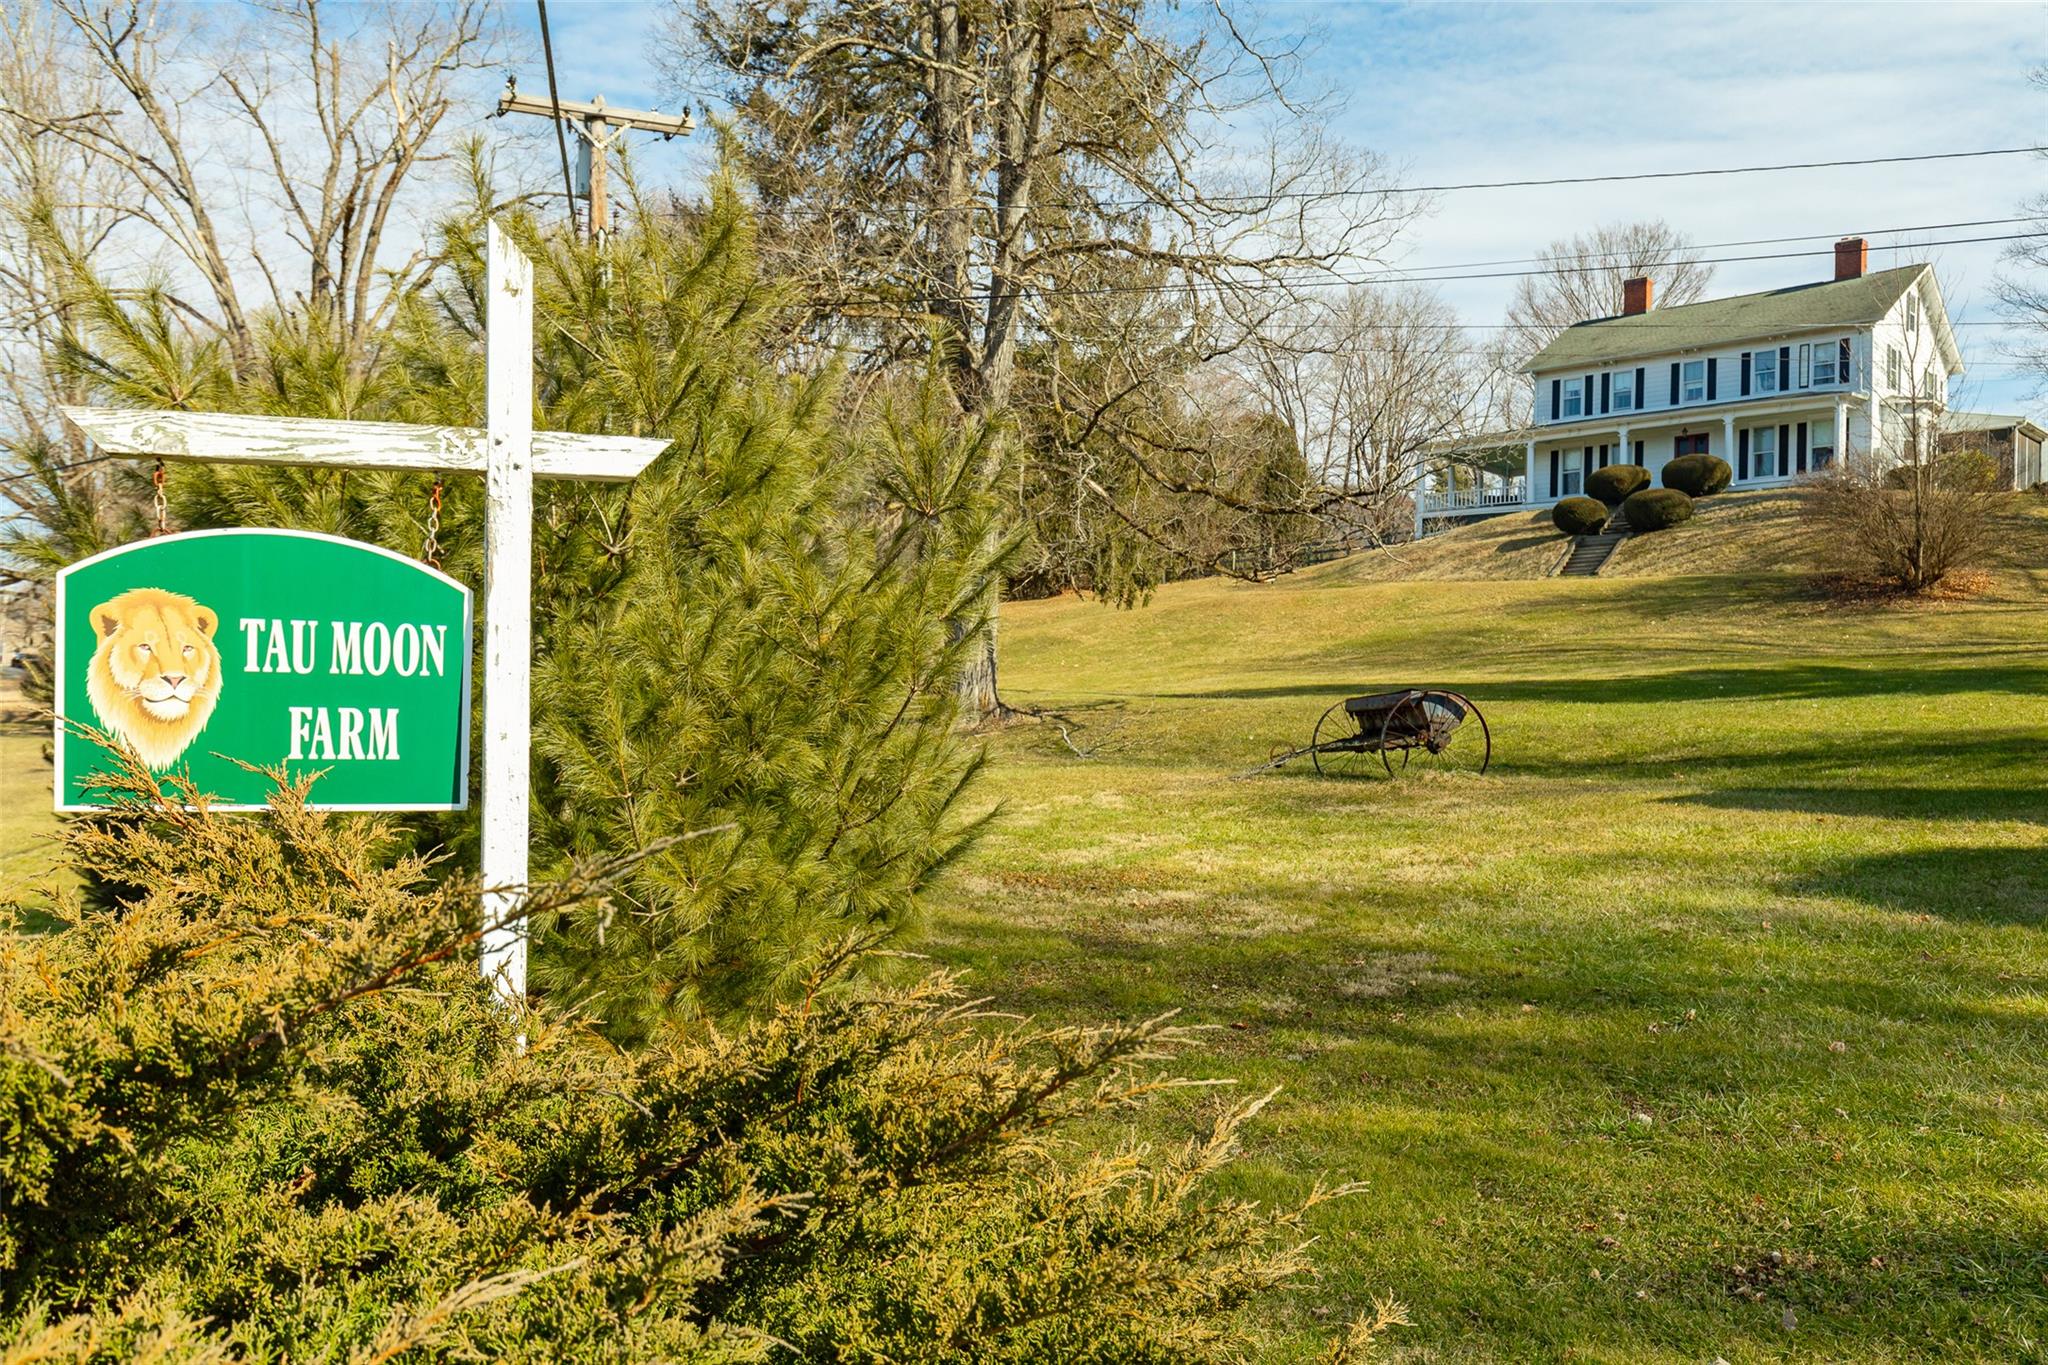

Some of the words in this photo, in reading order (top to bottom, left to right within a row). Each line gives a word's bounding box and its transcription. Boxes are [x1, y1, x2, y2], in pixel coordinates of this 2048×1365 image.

[239, 618, 318, 675] TAU
[329, 621, 448, 677] MOON
[287, 706, 400, 761] FARM
